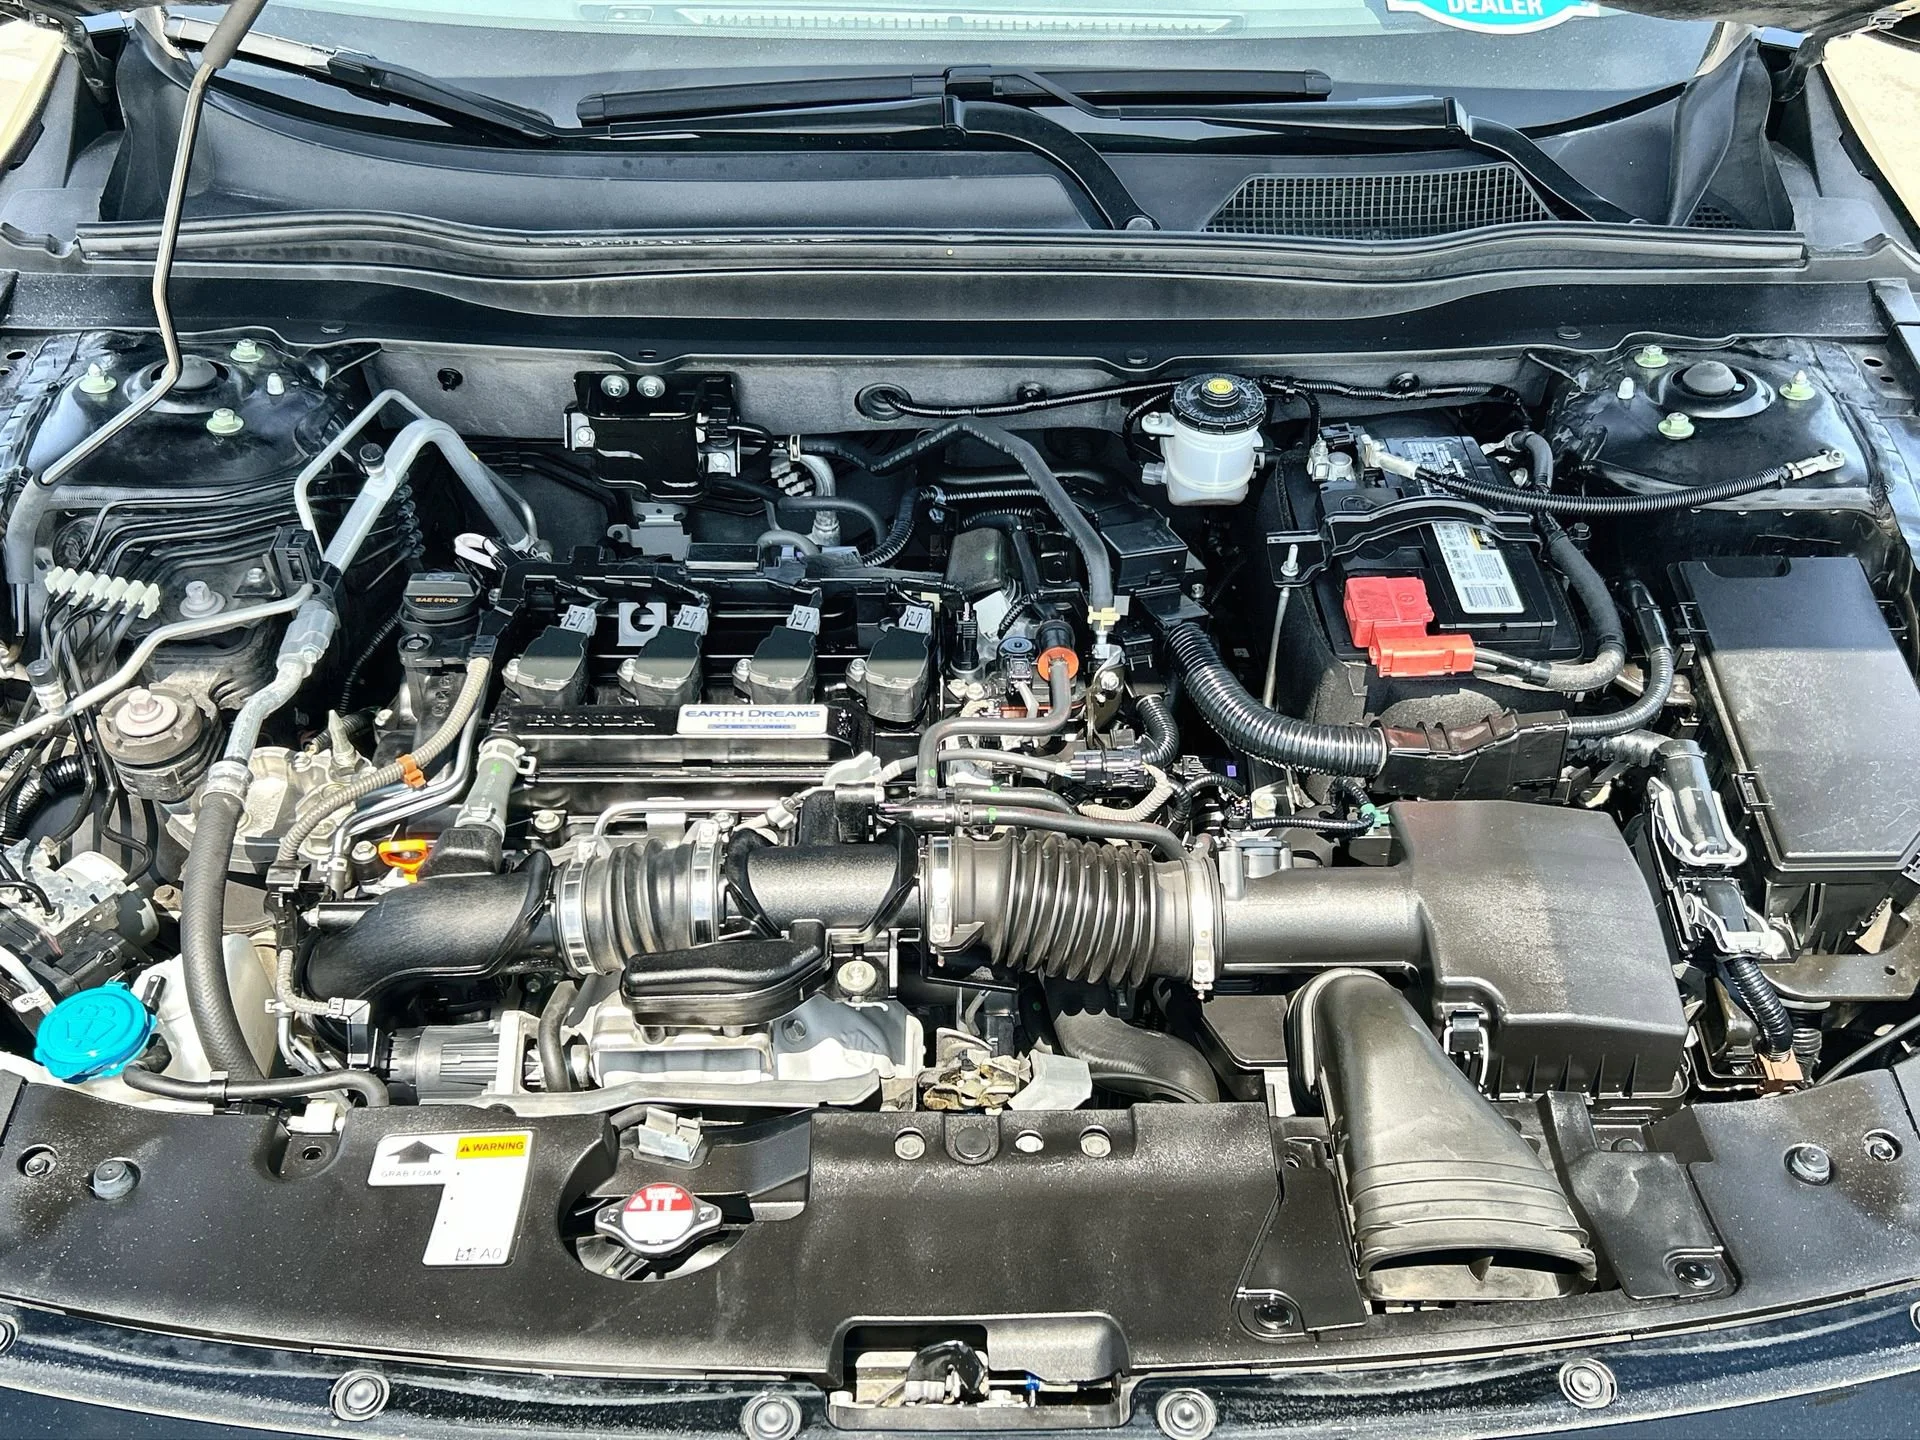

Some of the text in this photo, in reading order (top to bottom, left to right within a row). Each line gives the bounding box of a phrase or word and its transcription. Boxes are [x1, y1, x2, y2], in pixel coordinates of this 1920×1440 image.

[1447, 0, 1543, 15] DEALER
[748, 709, 821, 717] DREAMS
[472, 1142, 525, 1152] WARNING
